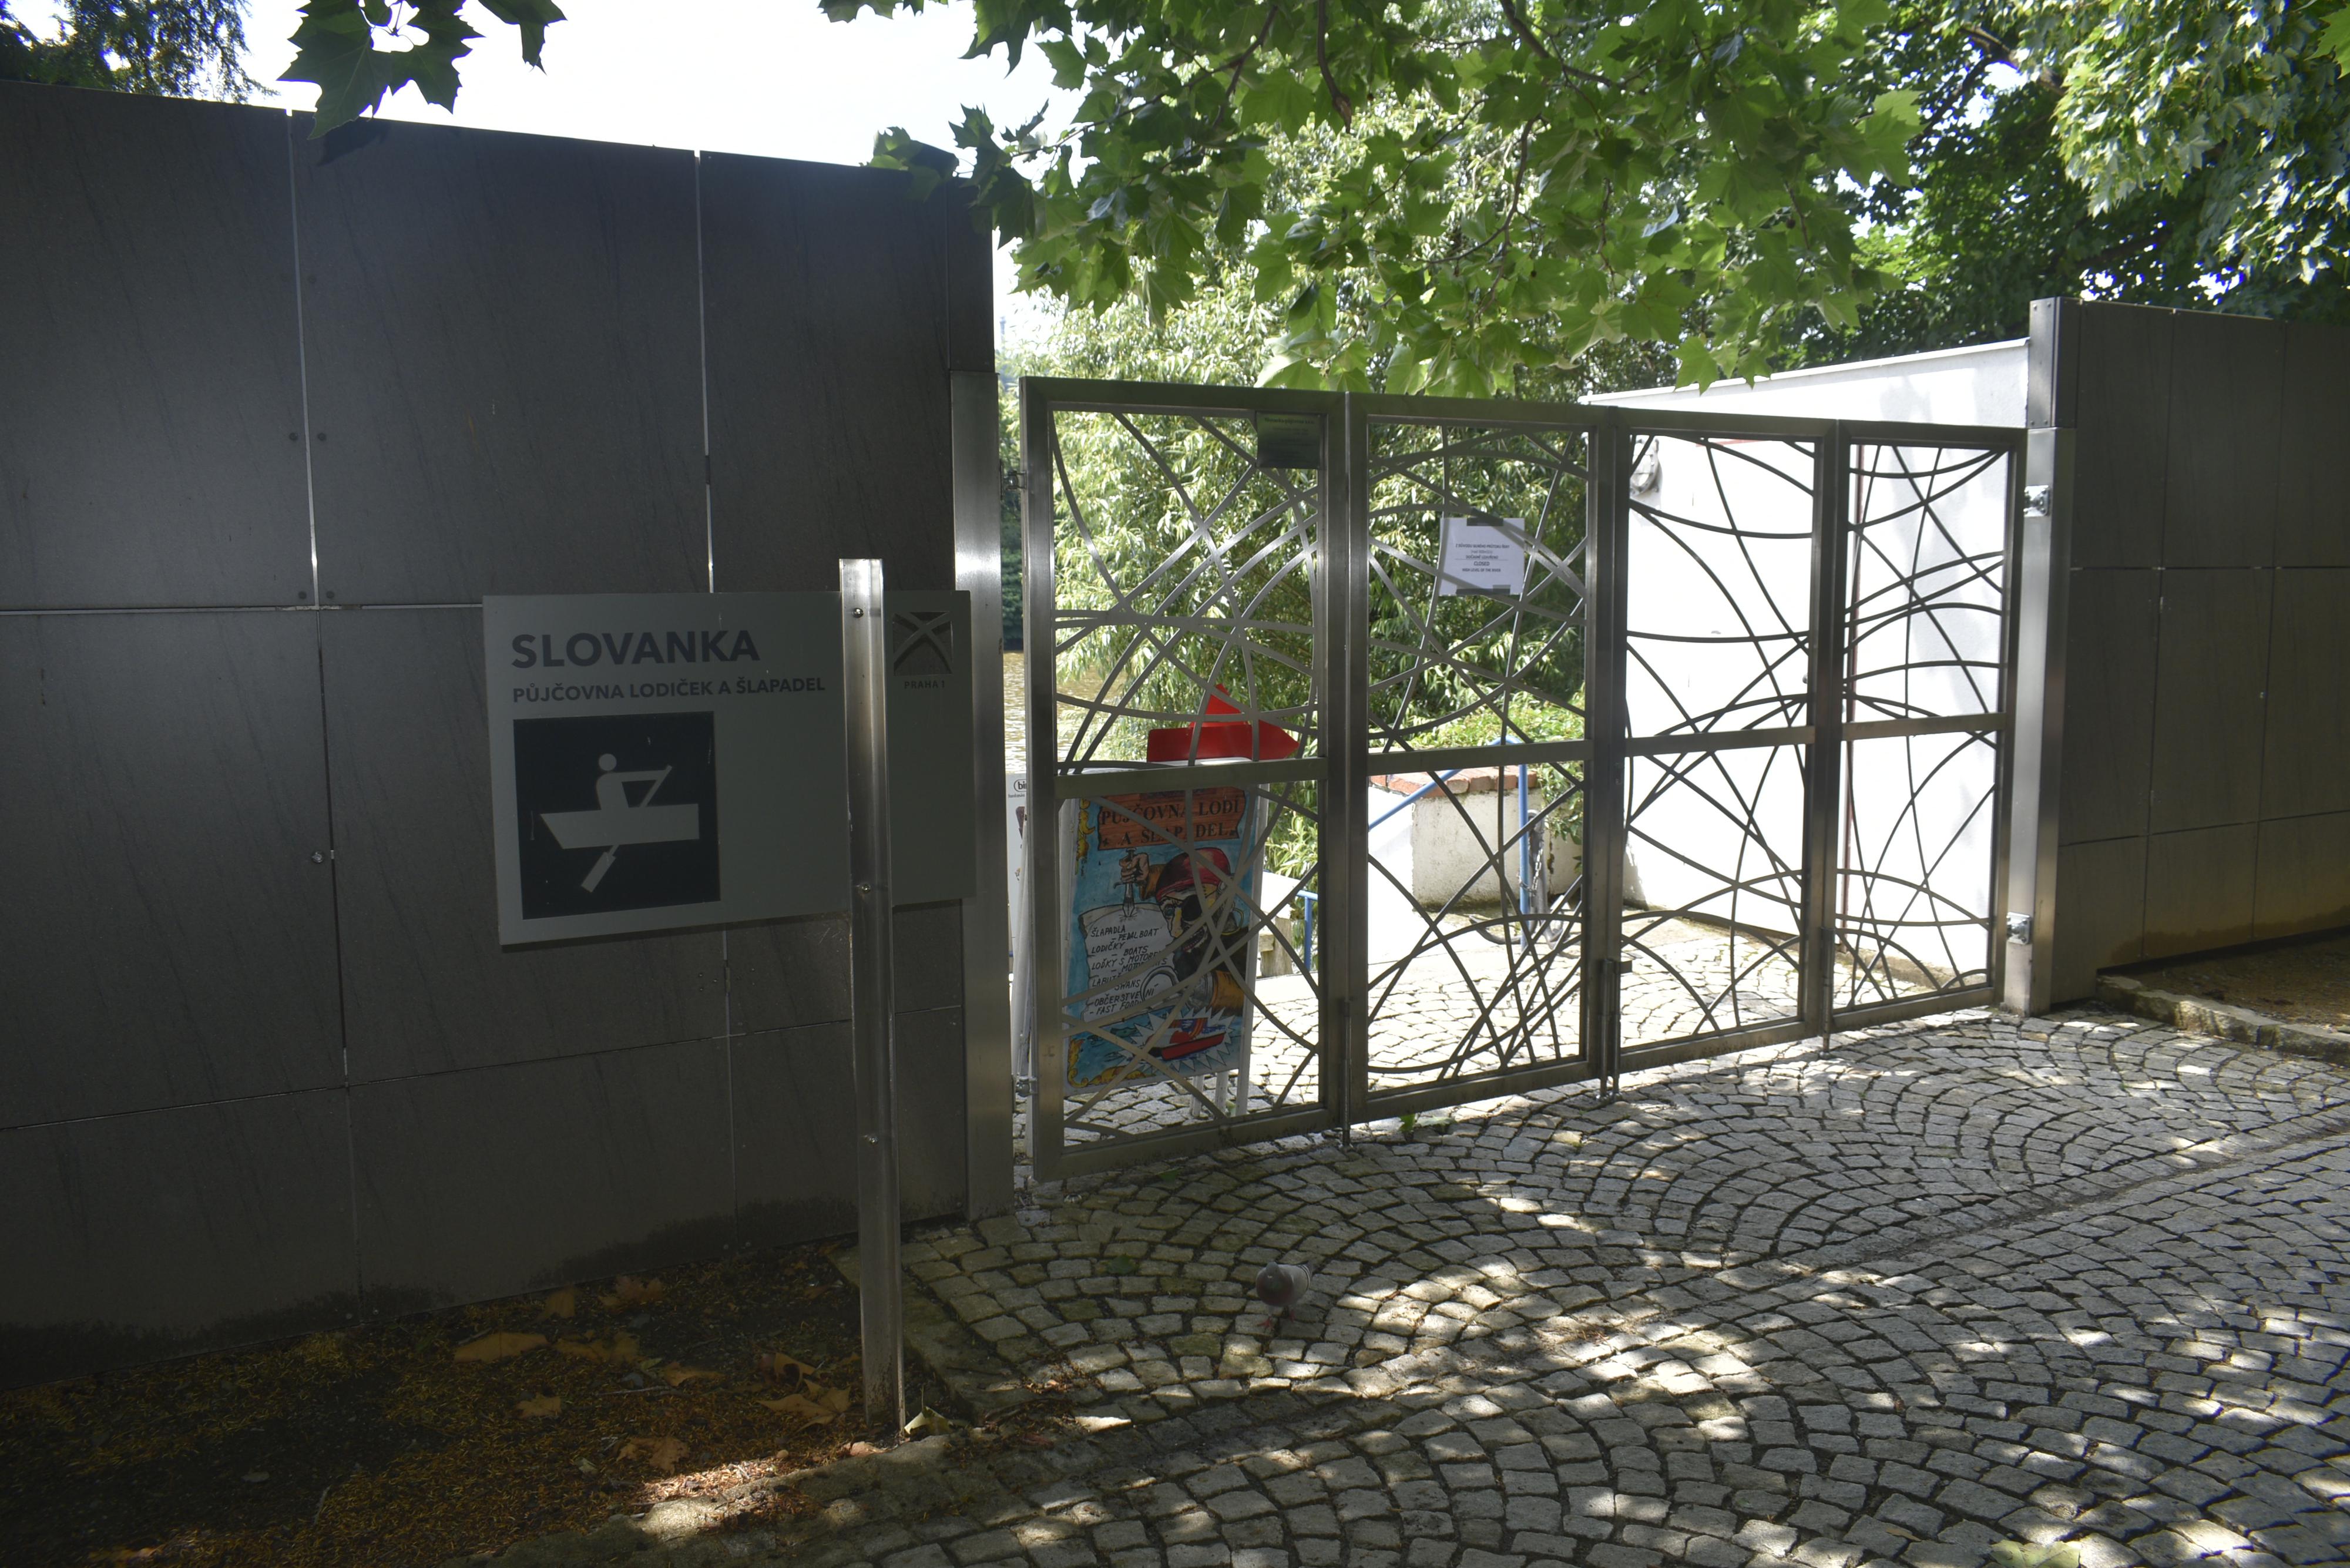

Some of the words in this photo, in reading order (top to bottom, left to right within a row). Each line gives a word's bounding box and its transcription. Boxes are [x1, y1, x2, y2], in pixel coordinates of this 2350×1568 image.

[512, 630, 760, 669] SLOVANKA
[513, 683, 624, 703] PŮJČOVNA
[630, 679, 713, 698] LODIČEK
[719, 681, 731, 695] A
[736, 677, 825, 694] ŠLAPADEL
[904, 680, 938, 689] PRAHA
[941, 680, 945, 688] 1
[1121, 832, 1132, 845] A
[1090, 925, 1126, 937] ŠLAPADLA
[1092, 941, 1126, 953] LODIČKY
[1123, 945, 1149, 956] BOATS
[1096, 1004, 1117, 1015] FAST
